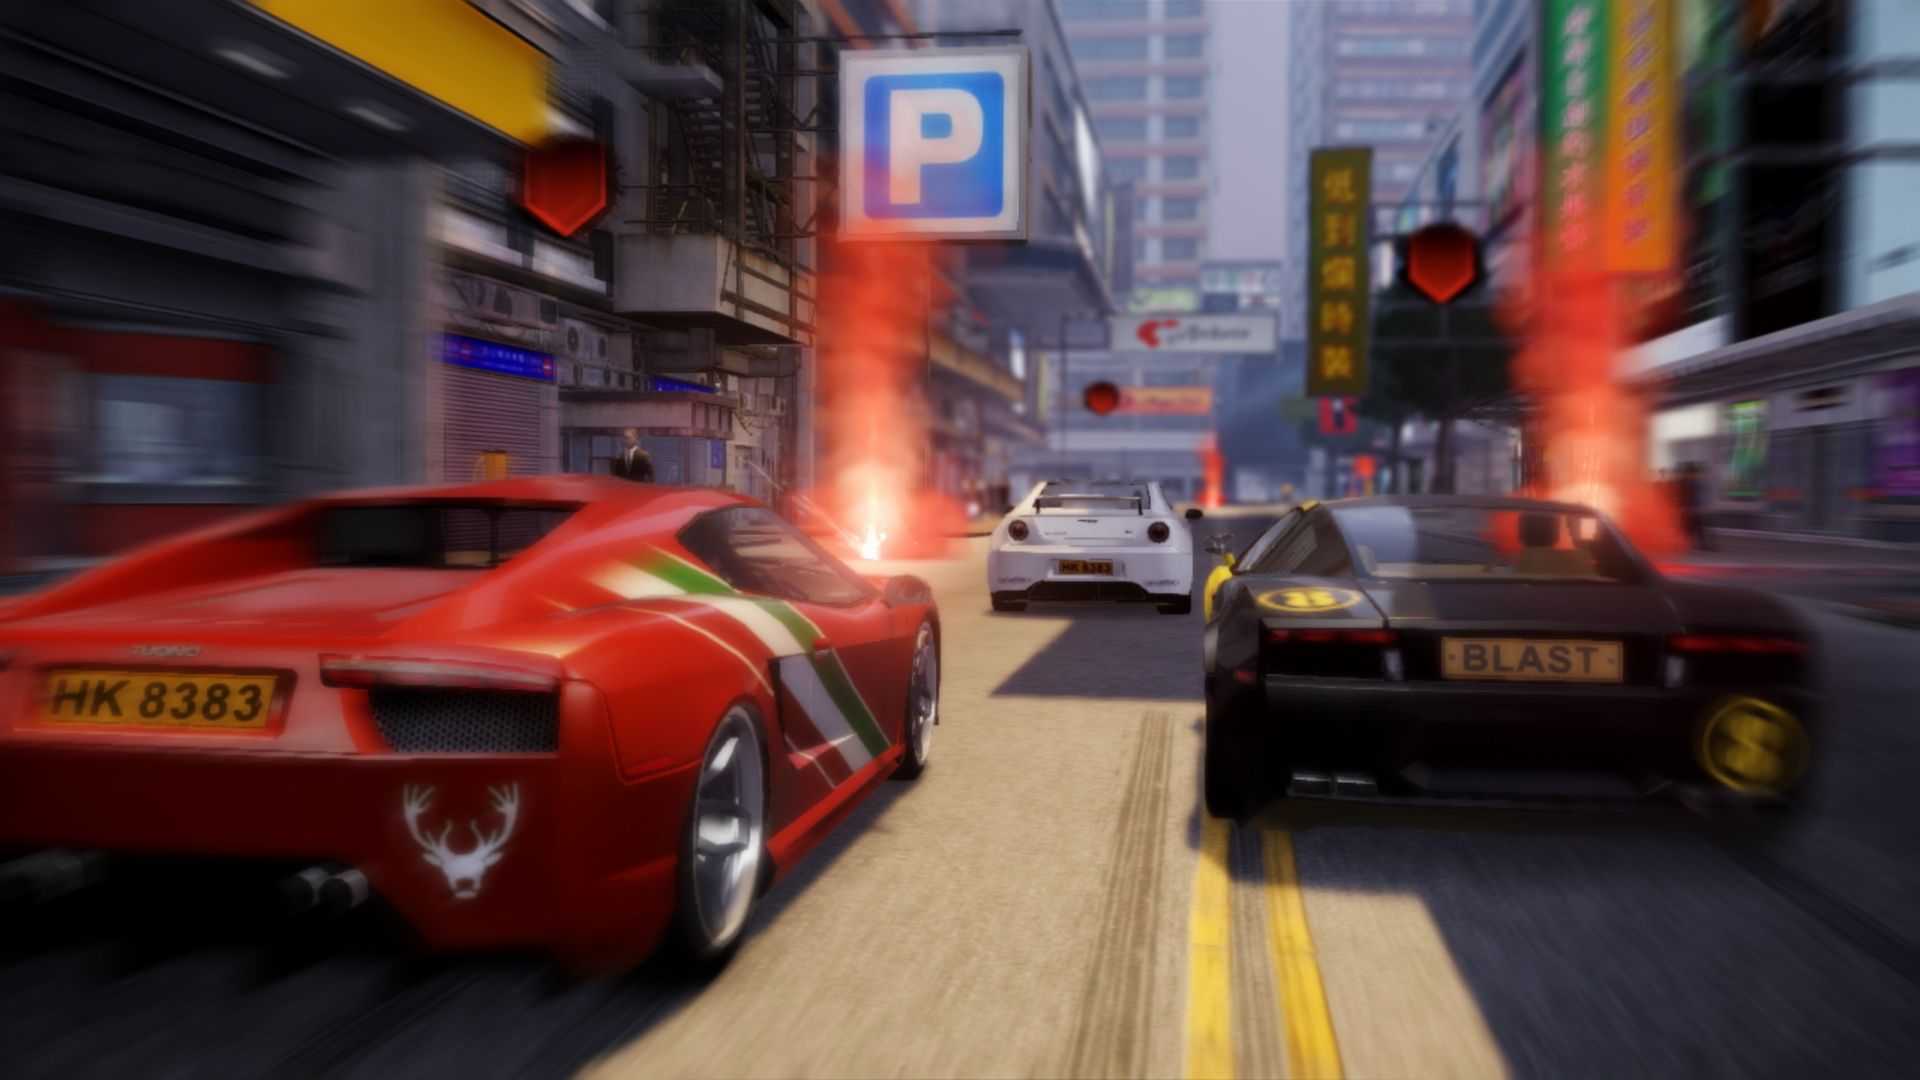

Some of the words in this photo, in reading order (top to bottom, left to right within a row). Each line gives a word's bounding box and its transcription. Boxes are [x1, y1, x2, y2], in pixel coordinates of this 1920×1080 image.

[889, 88, 984, 205] P
[1061, 560, 1080, 574] HK
[1462, 643, 1600, 674] BLAST
[51, 679, 131, 717] HK
[138, 681, 263, 722] 8383
